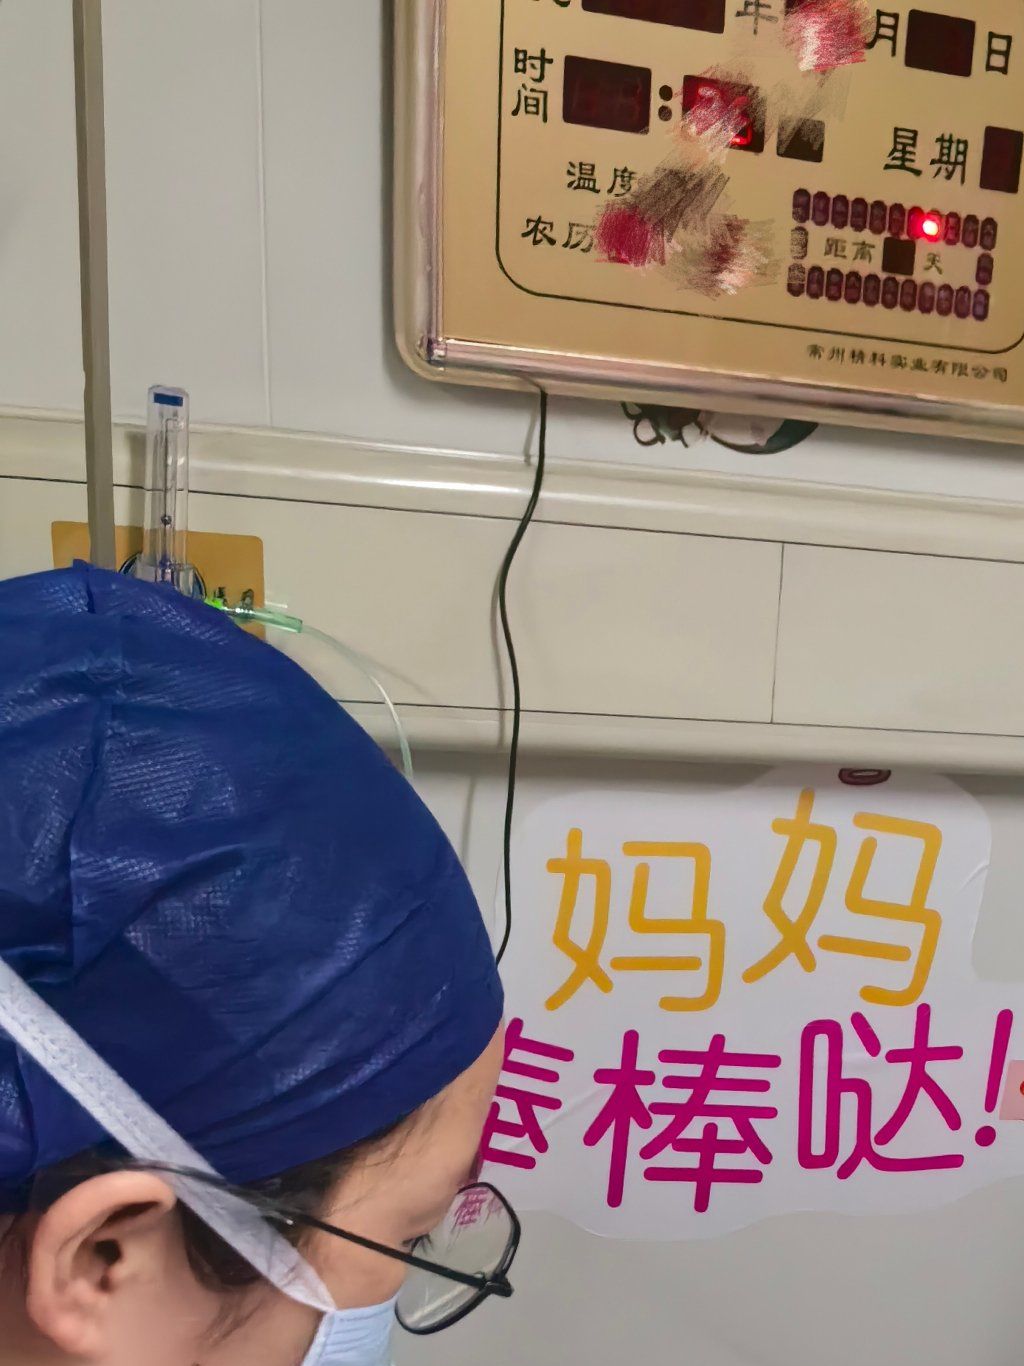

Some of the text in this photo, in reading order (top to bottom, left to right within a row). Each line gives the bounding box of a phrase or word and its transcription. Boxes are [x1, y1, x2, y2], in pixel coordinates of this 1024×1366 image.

[865, 8, 900, 58] 月
[985, 31, 1013, 75] 日
[511, 47, 554, 124] 时间
[566, 160, 637, 198] 温度
[883, 126, 969, 186] 星期
[520, 215, 596, 253] 农历
[824, 237, 943, 275] 距离 天
[545, 787, 943, 1012] 妈妈
